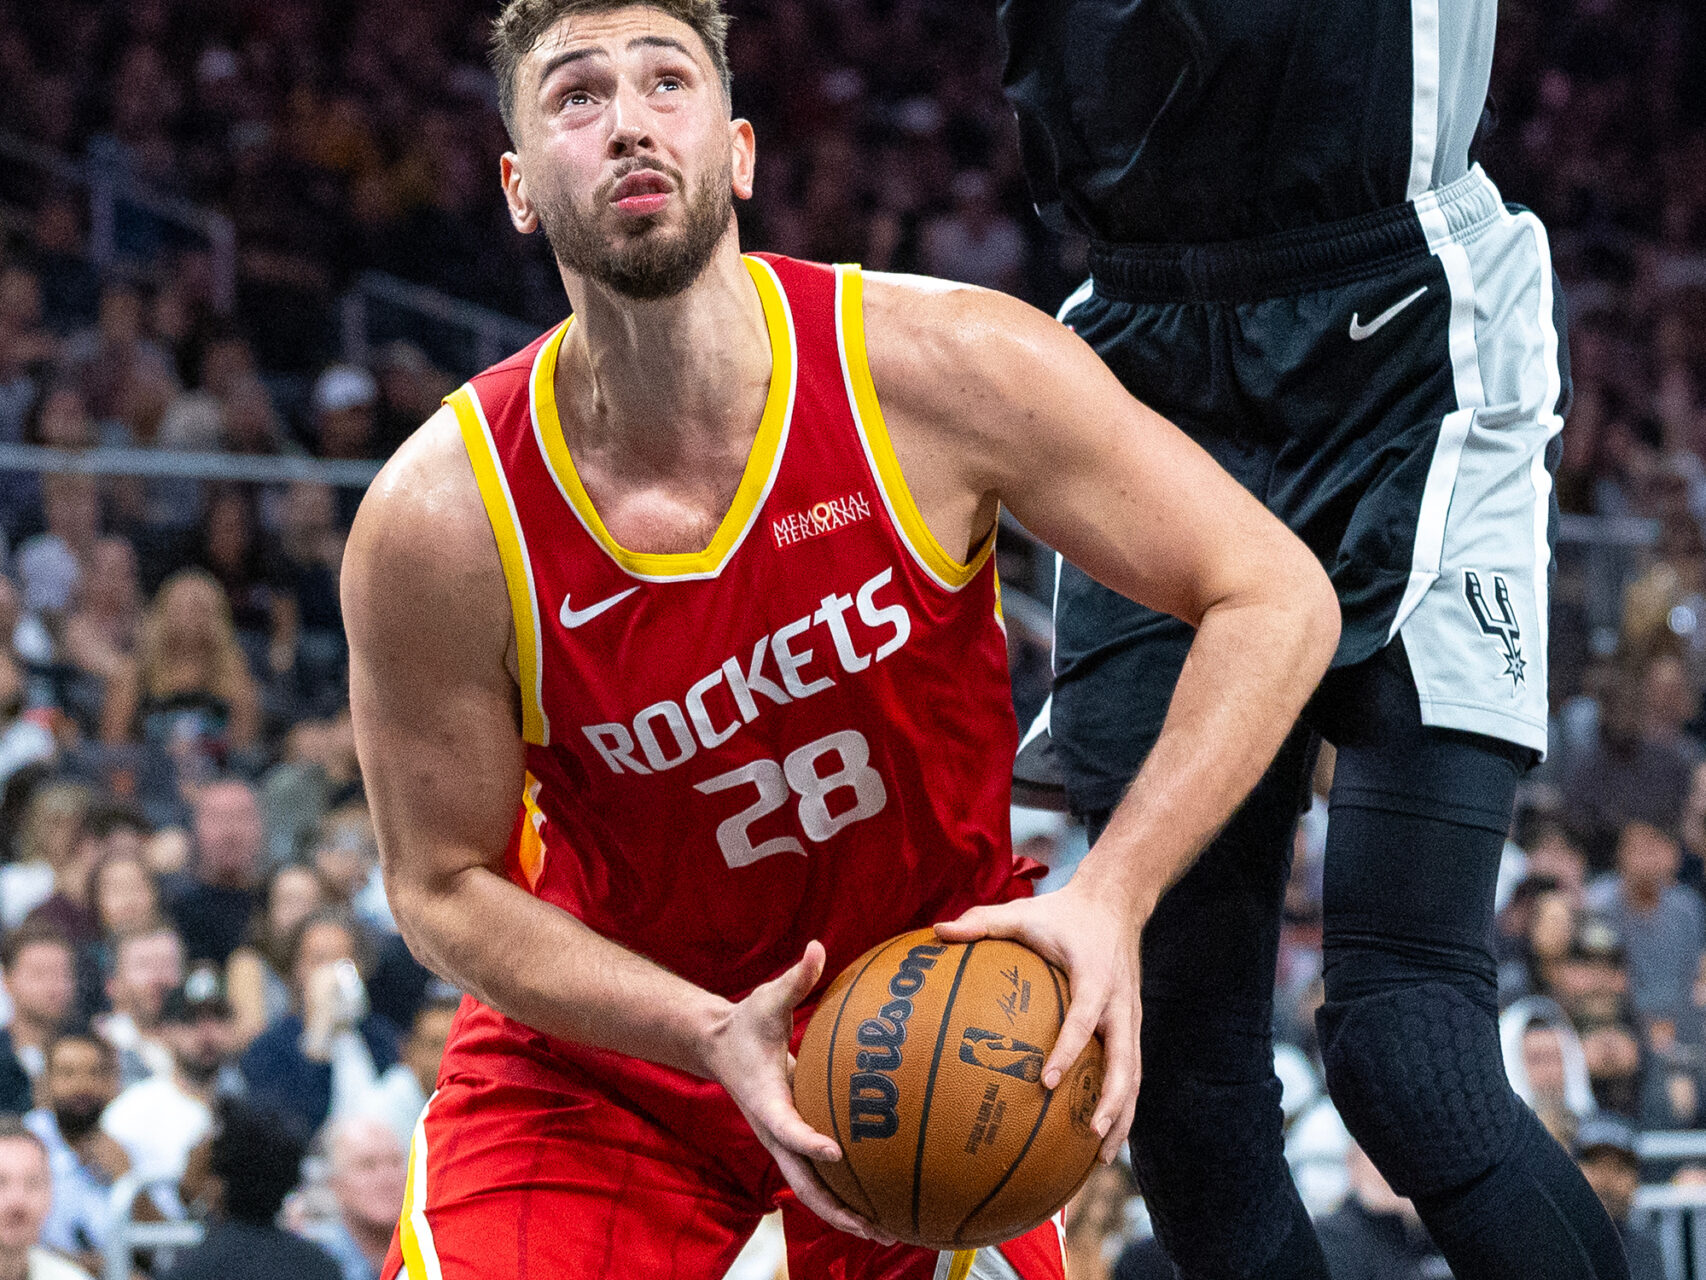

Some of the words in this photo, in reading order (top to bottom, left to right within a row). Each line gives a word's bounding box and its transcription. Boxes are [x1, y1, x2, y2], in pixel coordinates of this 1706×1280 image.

[773, 491, 869, 534] MEMORIAL
[774, 501, 871, 548] HERMANN
[692, 729, 888, 870] 28
[849, 943, 948, 1143] Wilson
